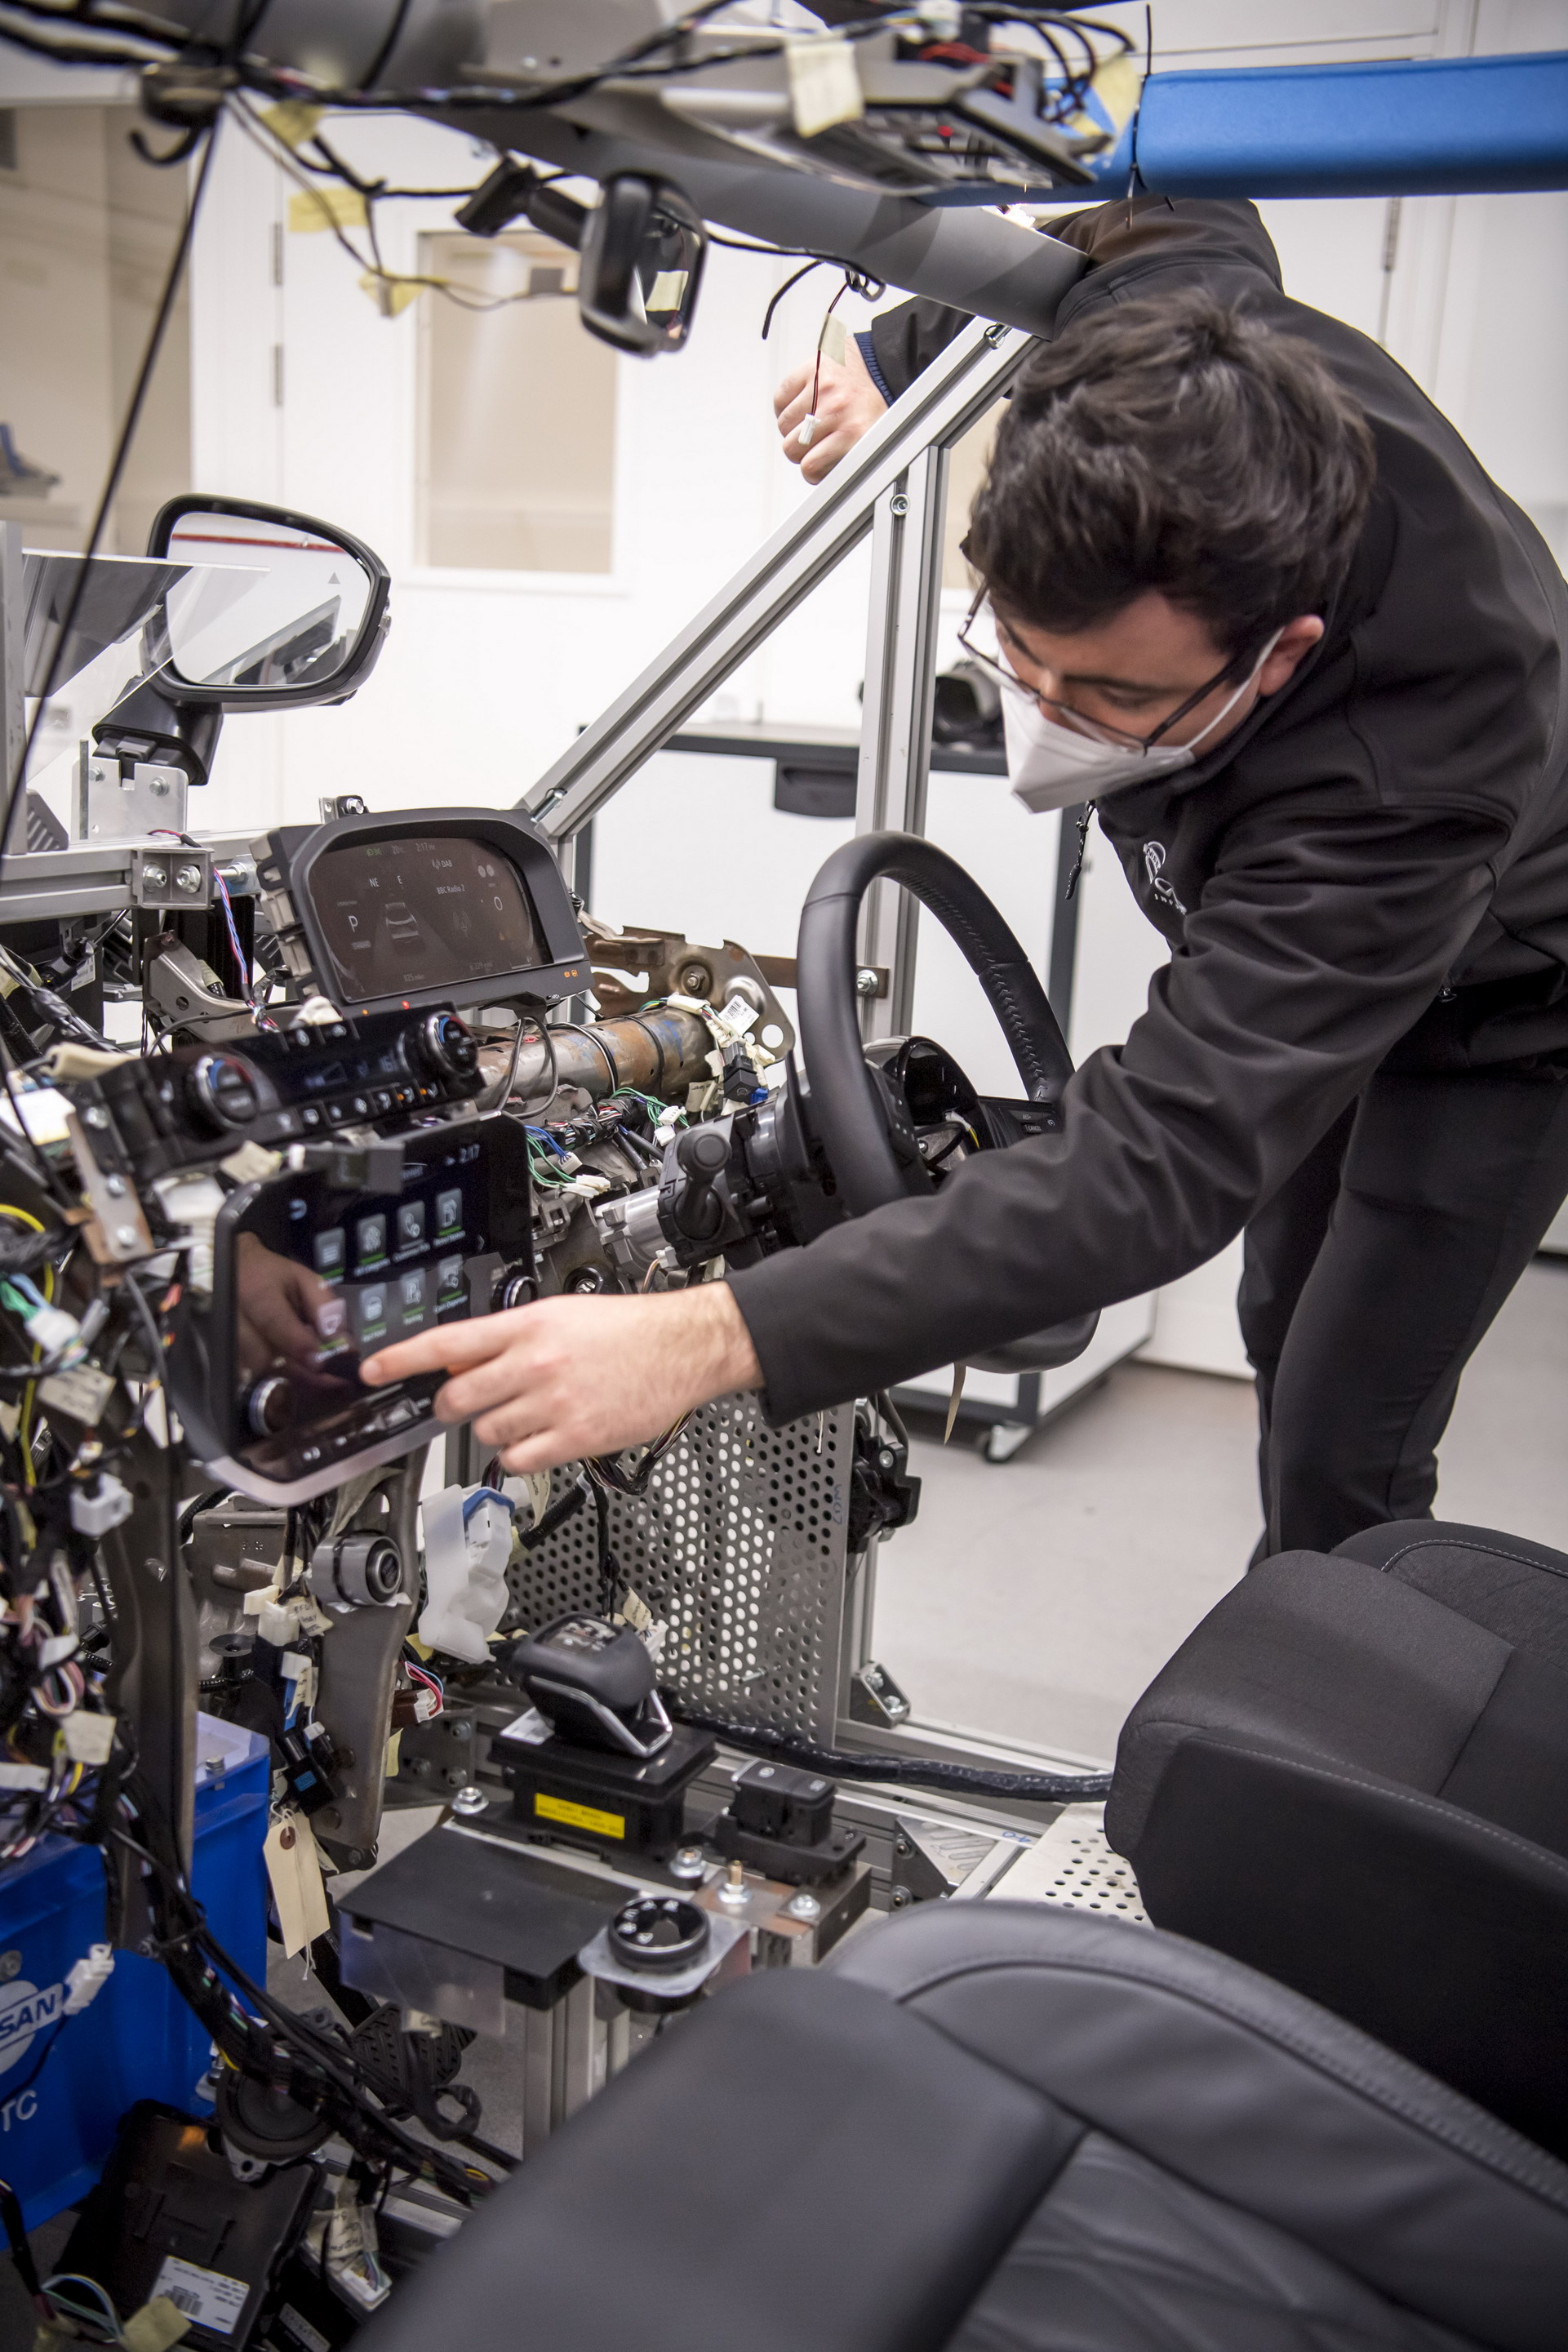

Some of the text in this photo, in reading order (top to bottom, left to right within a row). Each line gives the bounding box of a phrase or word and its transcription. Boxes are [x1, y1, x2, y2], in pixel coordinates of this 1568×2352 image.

[441, 859, 453, 868] DAB
[369, 878, 380, 887] NE
[397, 875, 403, 885] E
[437, 883, 466, 895] BBC Radio 2
[348, 915, 358, 932] P
